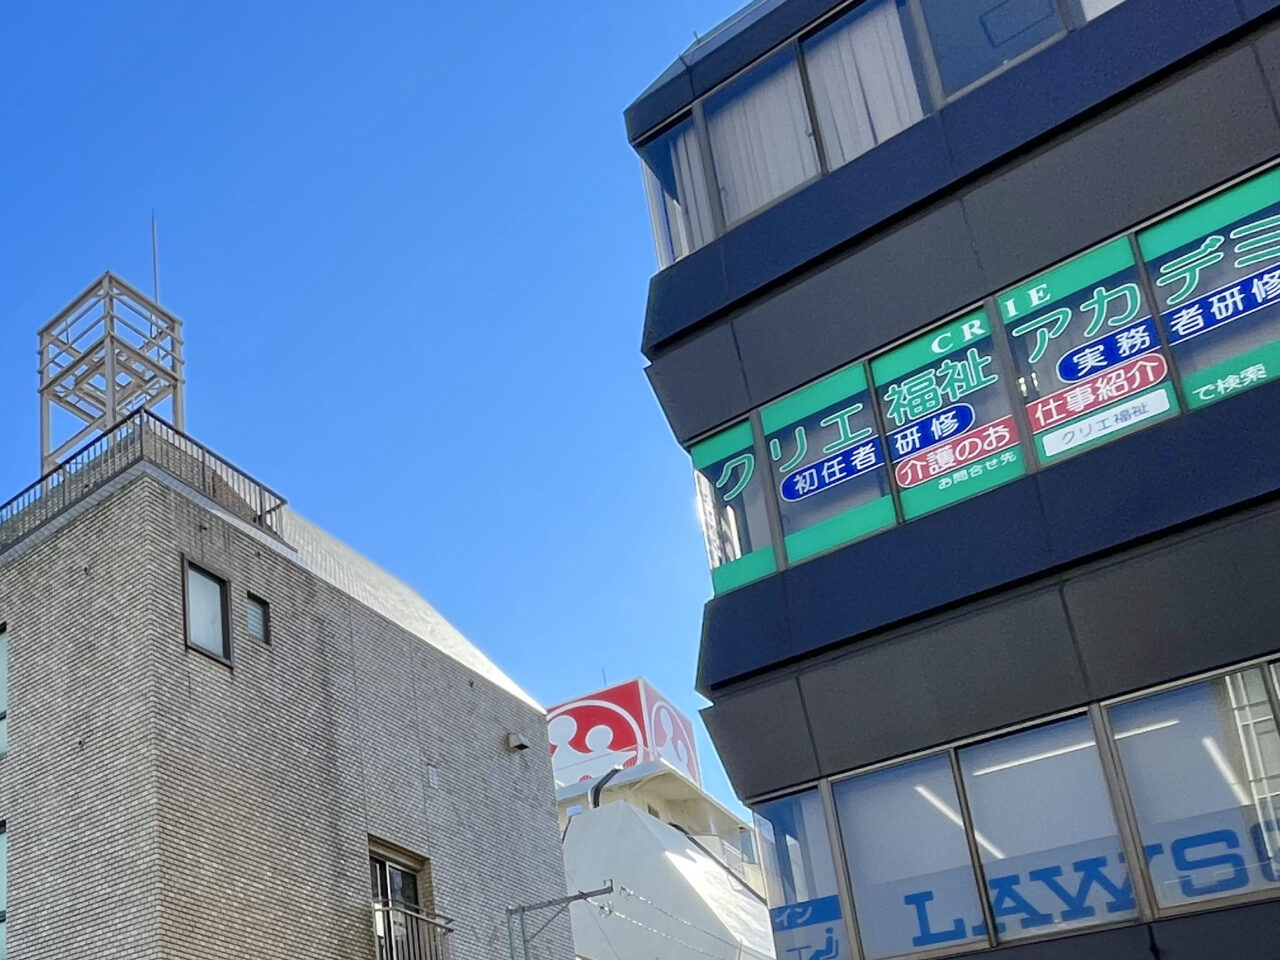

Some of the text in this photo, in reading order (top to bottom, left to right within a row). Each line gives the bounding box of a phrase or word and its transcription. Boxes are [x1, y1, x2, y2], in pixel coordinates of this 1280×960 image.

[1192, 364, 1267, 400] で検索
[1061, 402, 1148, 445] クリエ福祉
[793, 410, 960, 496] 初任者研修
[938, 451, 1017, 490] お問合せ先
